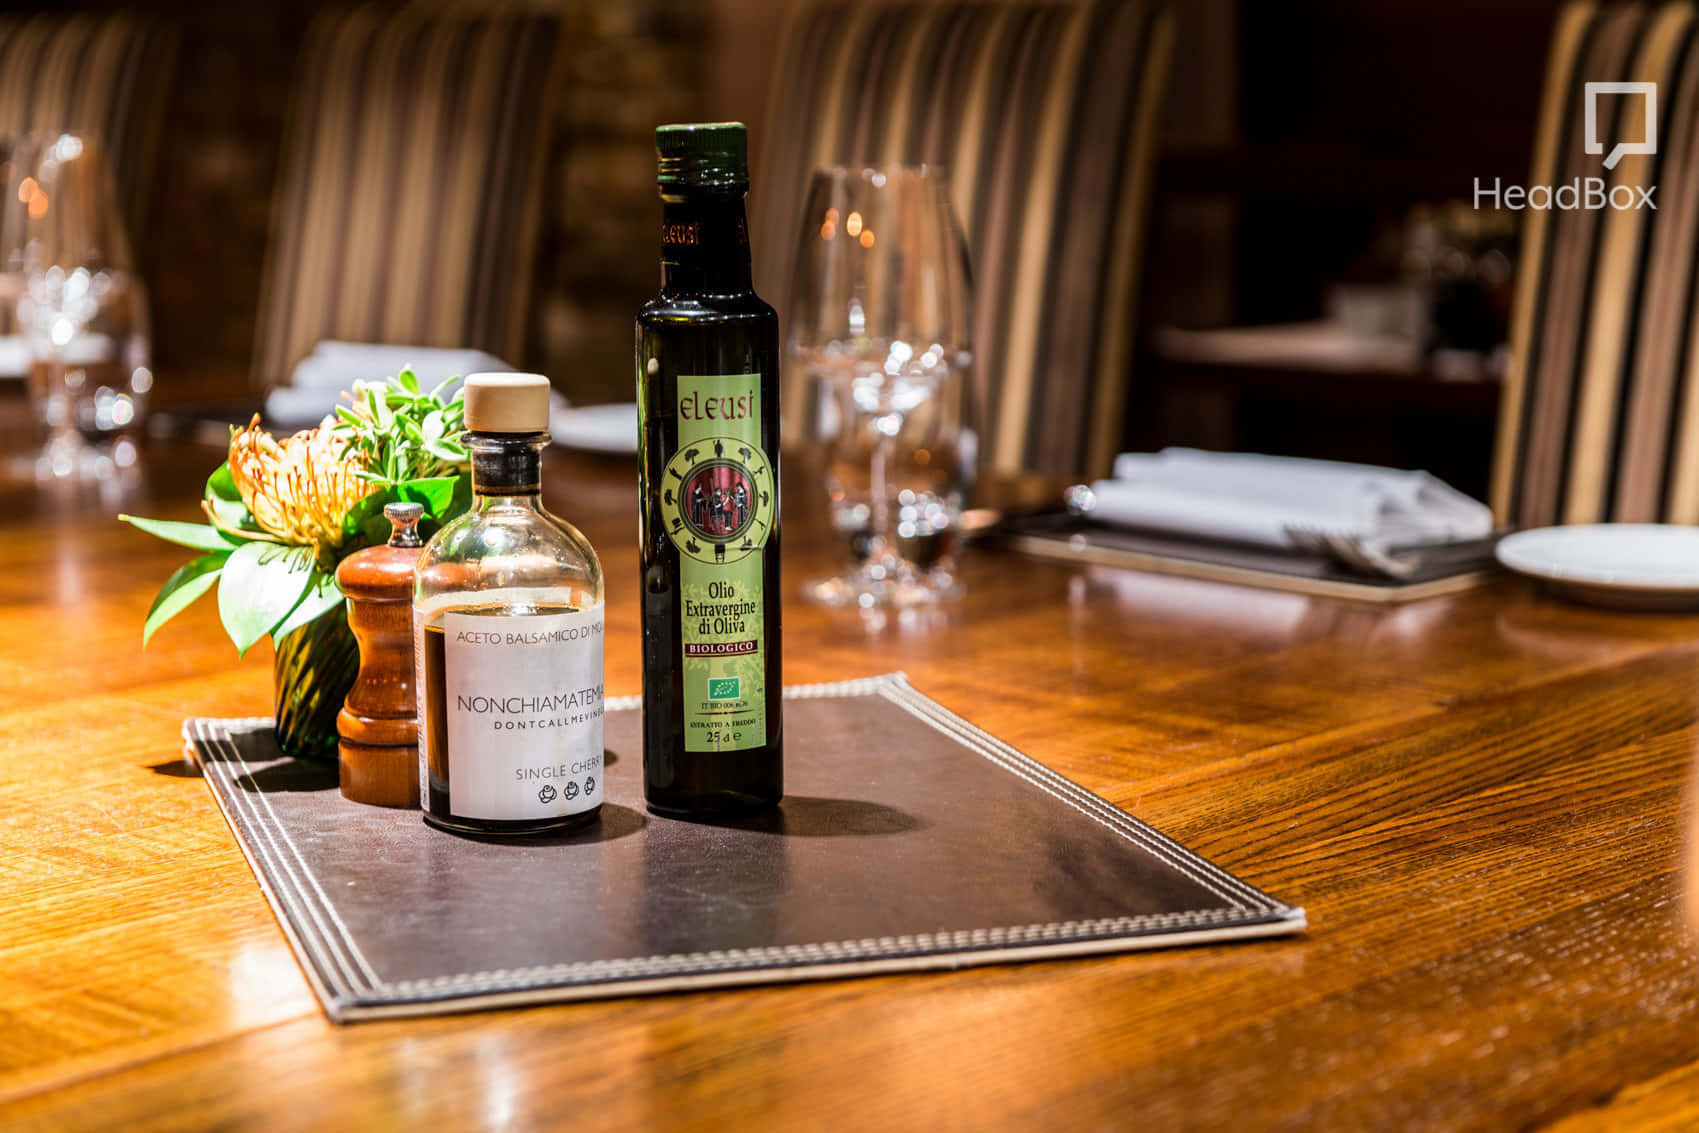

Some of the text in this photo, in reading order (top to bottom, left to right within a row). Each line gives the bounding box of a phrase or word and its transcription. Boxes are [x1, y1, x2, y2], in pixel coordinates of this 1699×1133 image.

[680, 390, 754, 421] eleusi
[708, 581, 735, 599] Olio
[685, 598, 756, 621] Extravergine
[699, 617, 746, 635] di Oliva
[456, 631, 502, 646] ACETO
[506, 628, 579, 645] BALSAMICO
[581, 625, 590, 640] DI
[689, 641, 754, 654] BIOLOGICO
[515, 764, 567, 780] SINGLE
